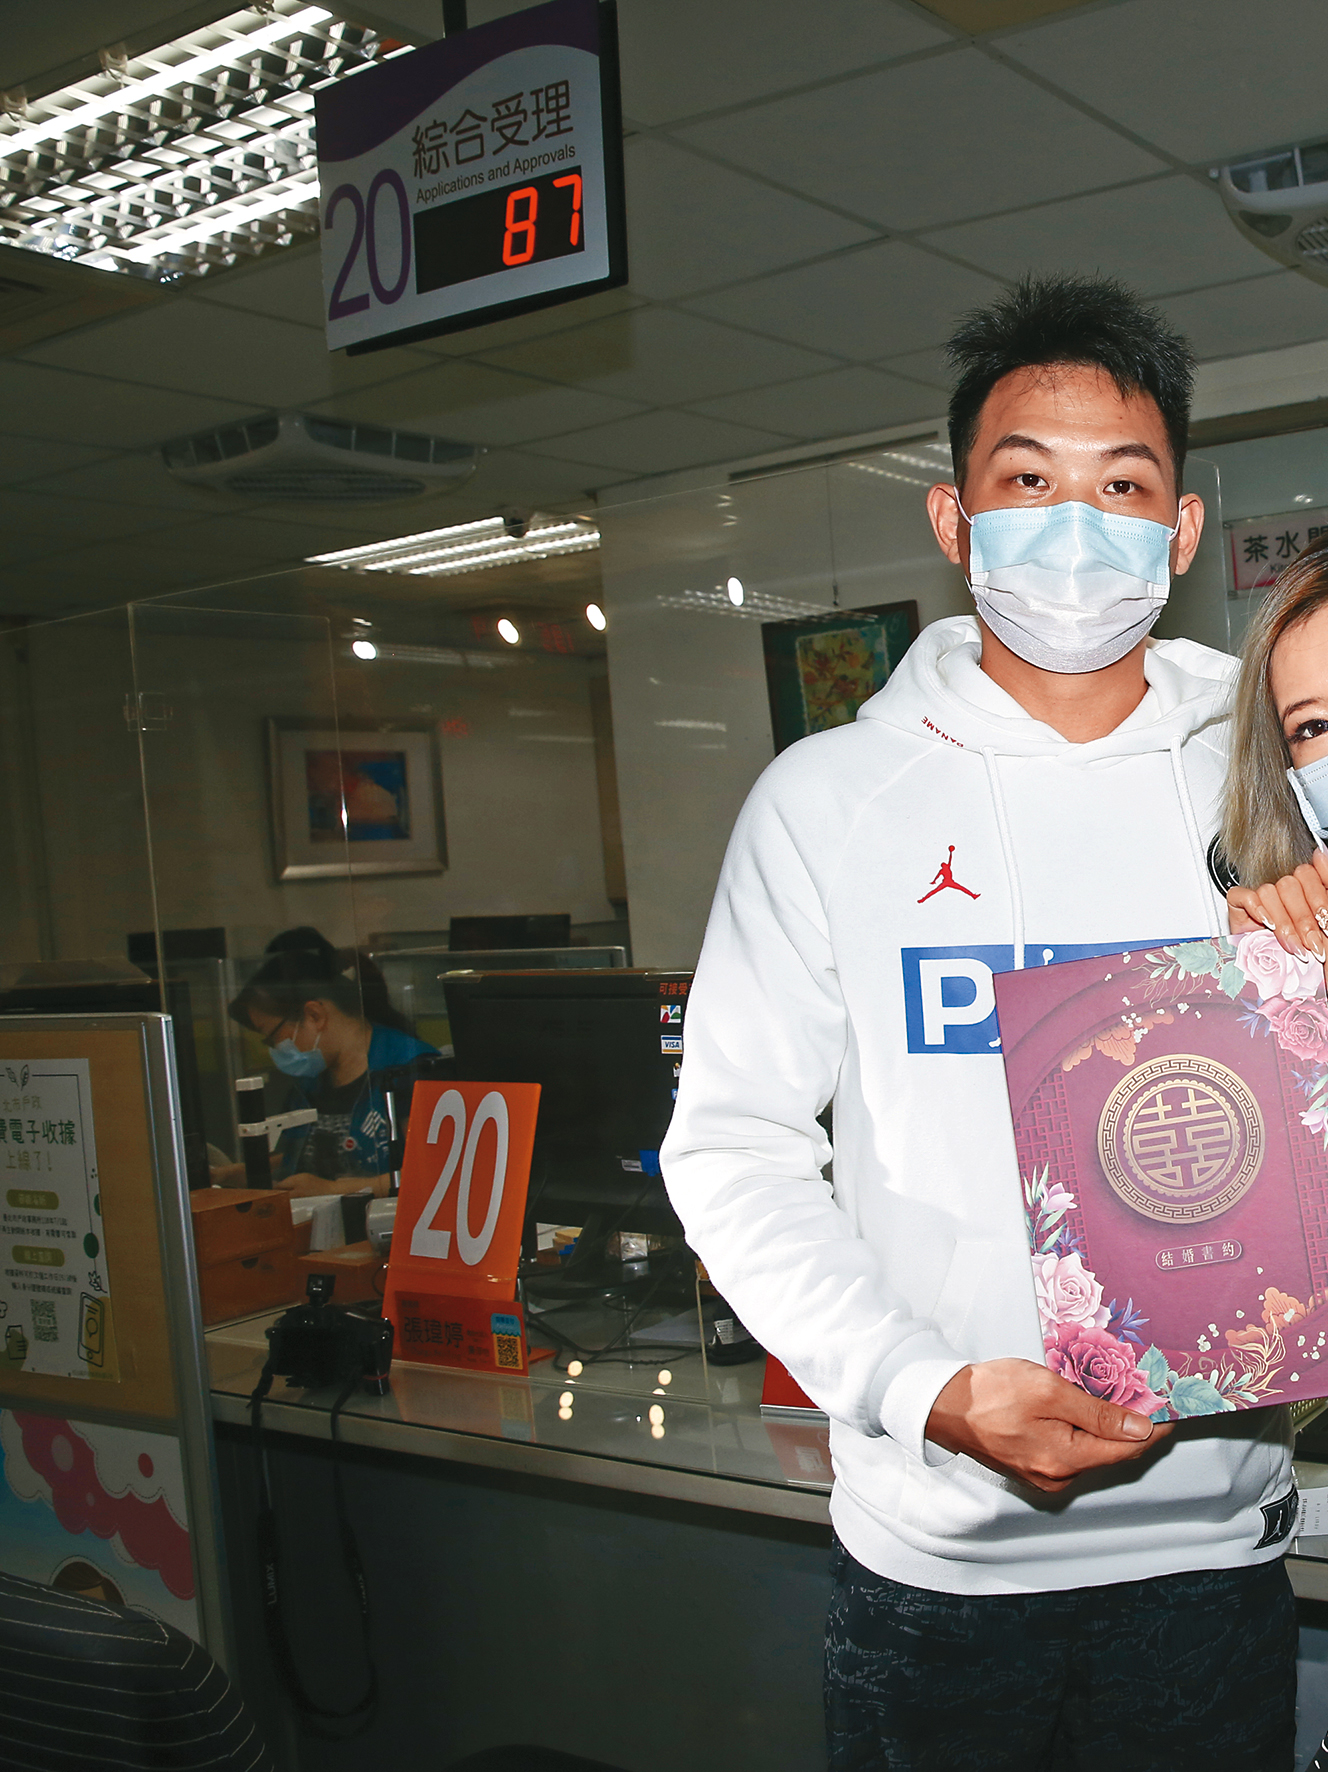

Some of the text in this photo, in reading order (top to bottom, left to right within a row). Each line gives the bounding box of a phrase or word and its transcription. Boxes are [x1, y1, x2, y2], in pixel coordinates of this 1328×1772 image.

[412, 80, 574, 178] 綜合受理
[416, 144, 576, 203] Applications and Approvals
[324, 169, 411, 321] 20
[502, 174, 582, 266] 87
[659, 982, 692, 996] 可接受
[665, 1041, 680, 1049] VISA
[410, 1089, 509, 1266] 20
[1161, 1241, 1235, 1267] 結婚書約
